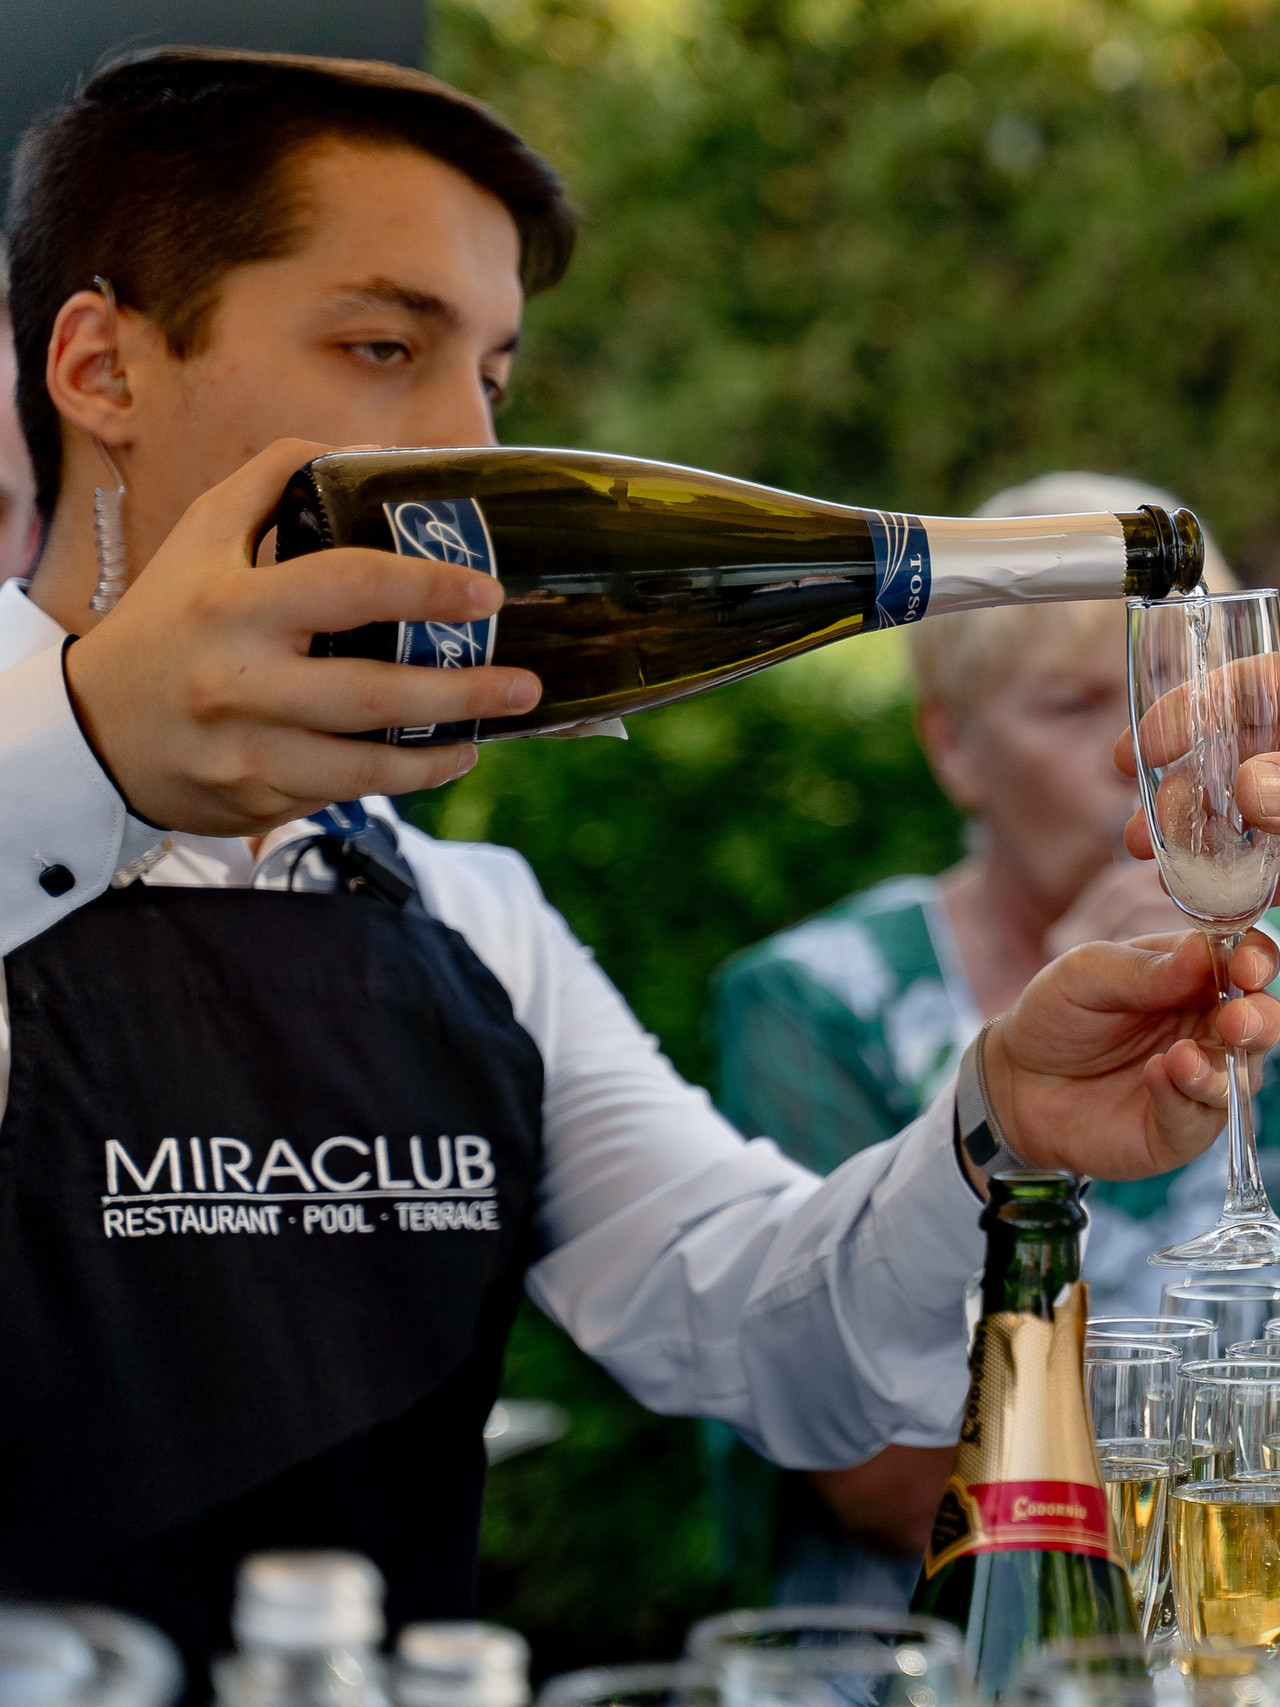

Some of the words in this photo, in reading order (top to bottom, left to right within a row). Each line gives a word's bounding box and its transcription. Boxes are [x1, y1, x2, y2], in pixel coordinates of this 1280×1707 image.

[903, 553, 923, 621] TOSO
[105, 1135, 497, 1195] MIRACLUB
[103, 1206, 282, 1238] RESTAURANT
[303, 1204, 376, 1235] POOL
[396, 1202, 501, 1232] TERRACE
